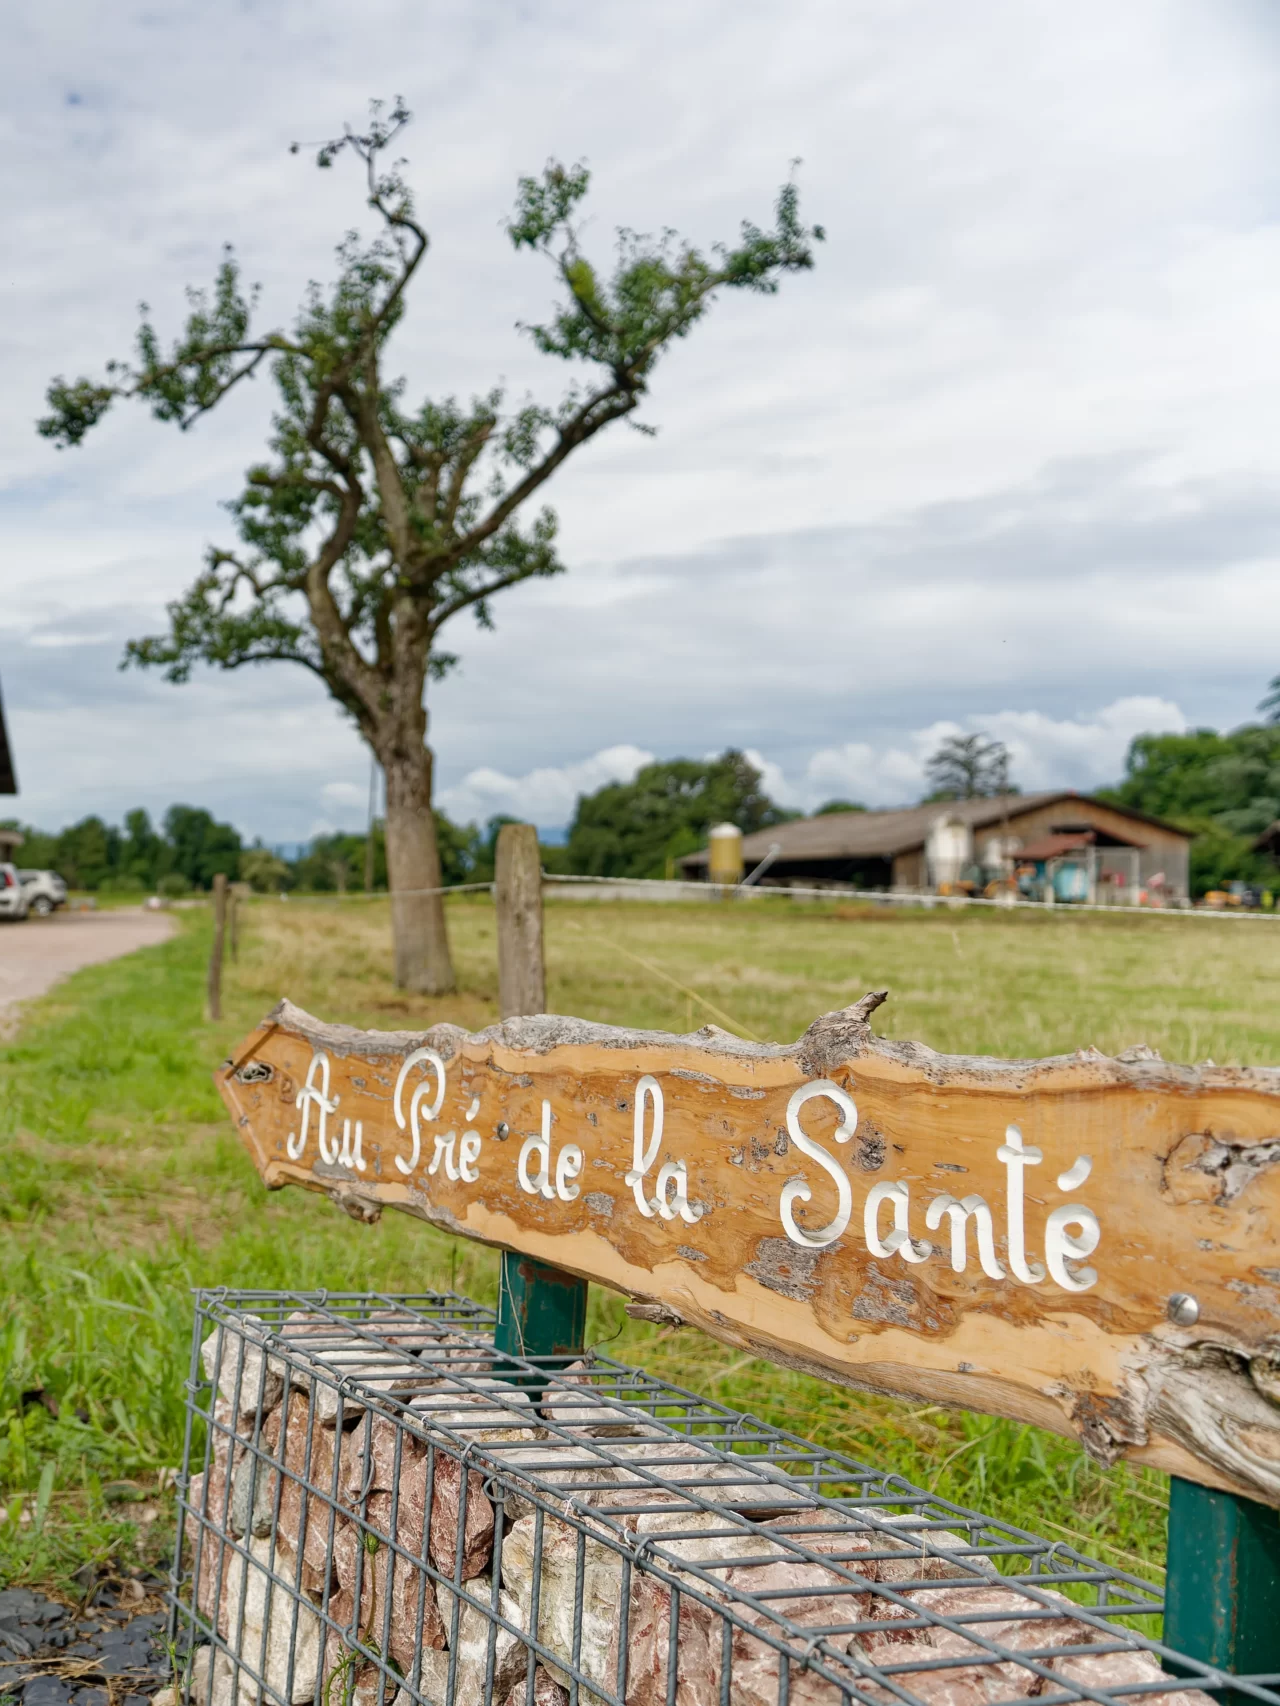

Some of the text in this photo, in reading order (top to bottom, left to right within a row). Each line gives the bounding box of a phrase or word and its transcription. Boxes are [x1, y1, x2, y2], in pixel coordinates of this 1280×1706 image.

[287, 1046, 1101, 1291] Au Pré de la Santé
